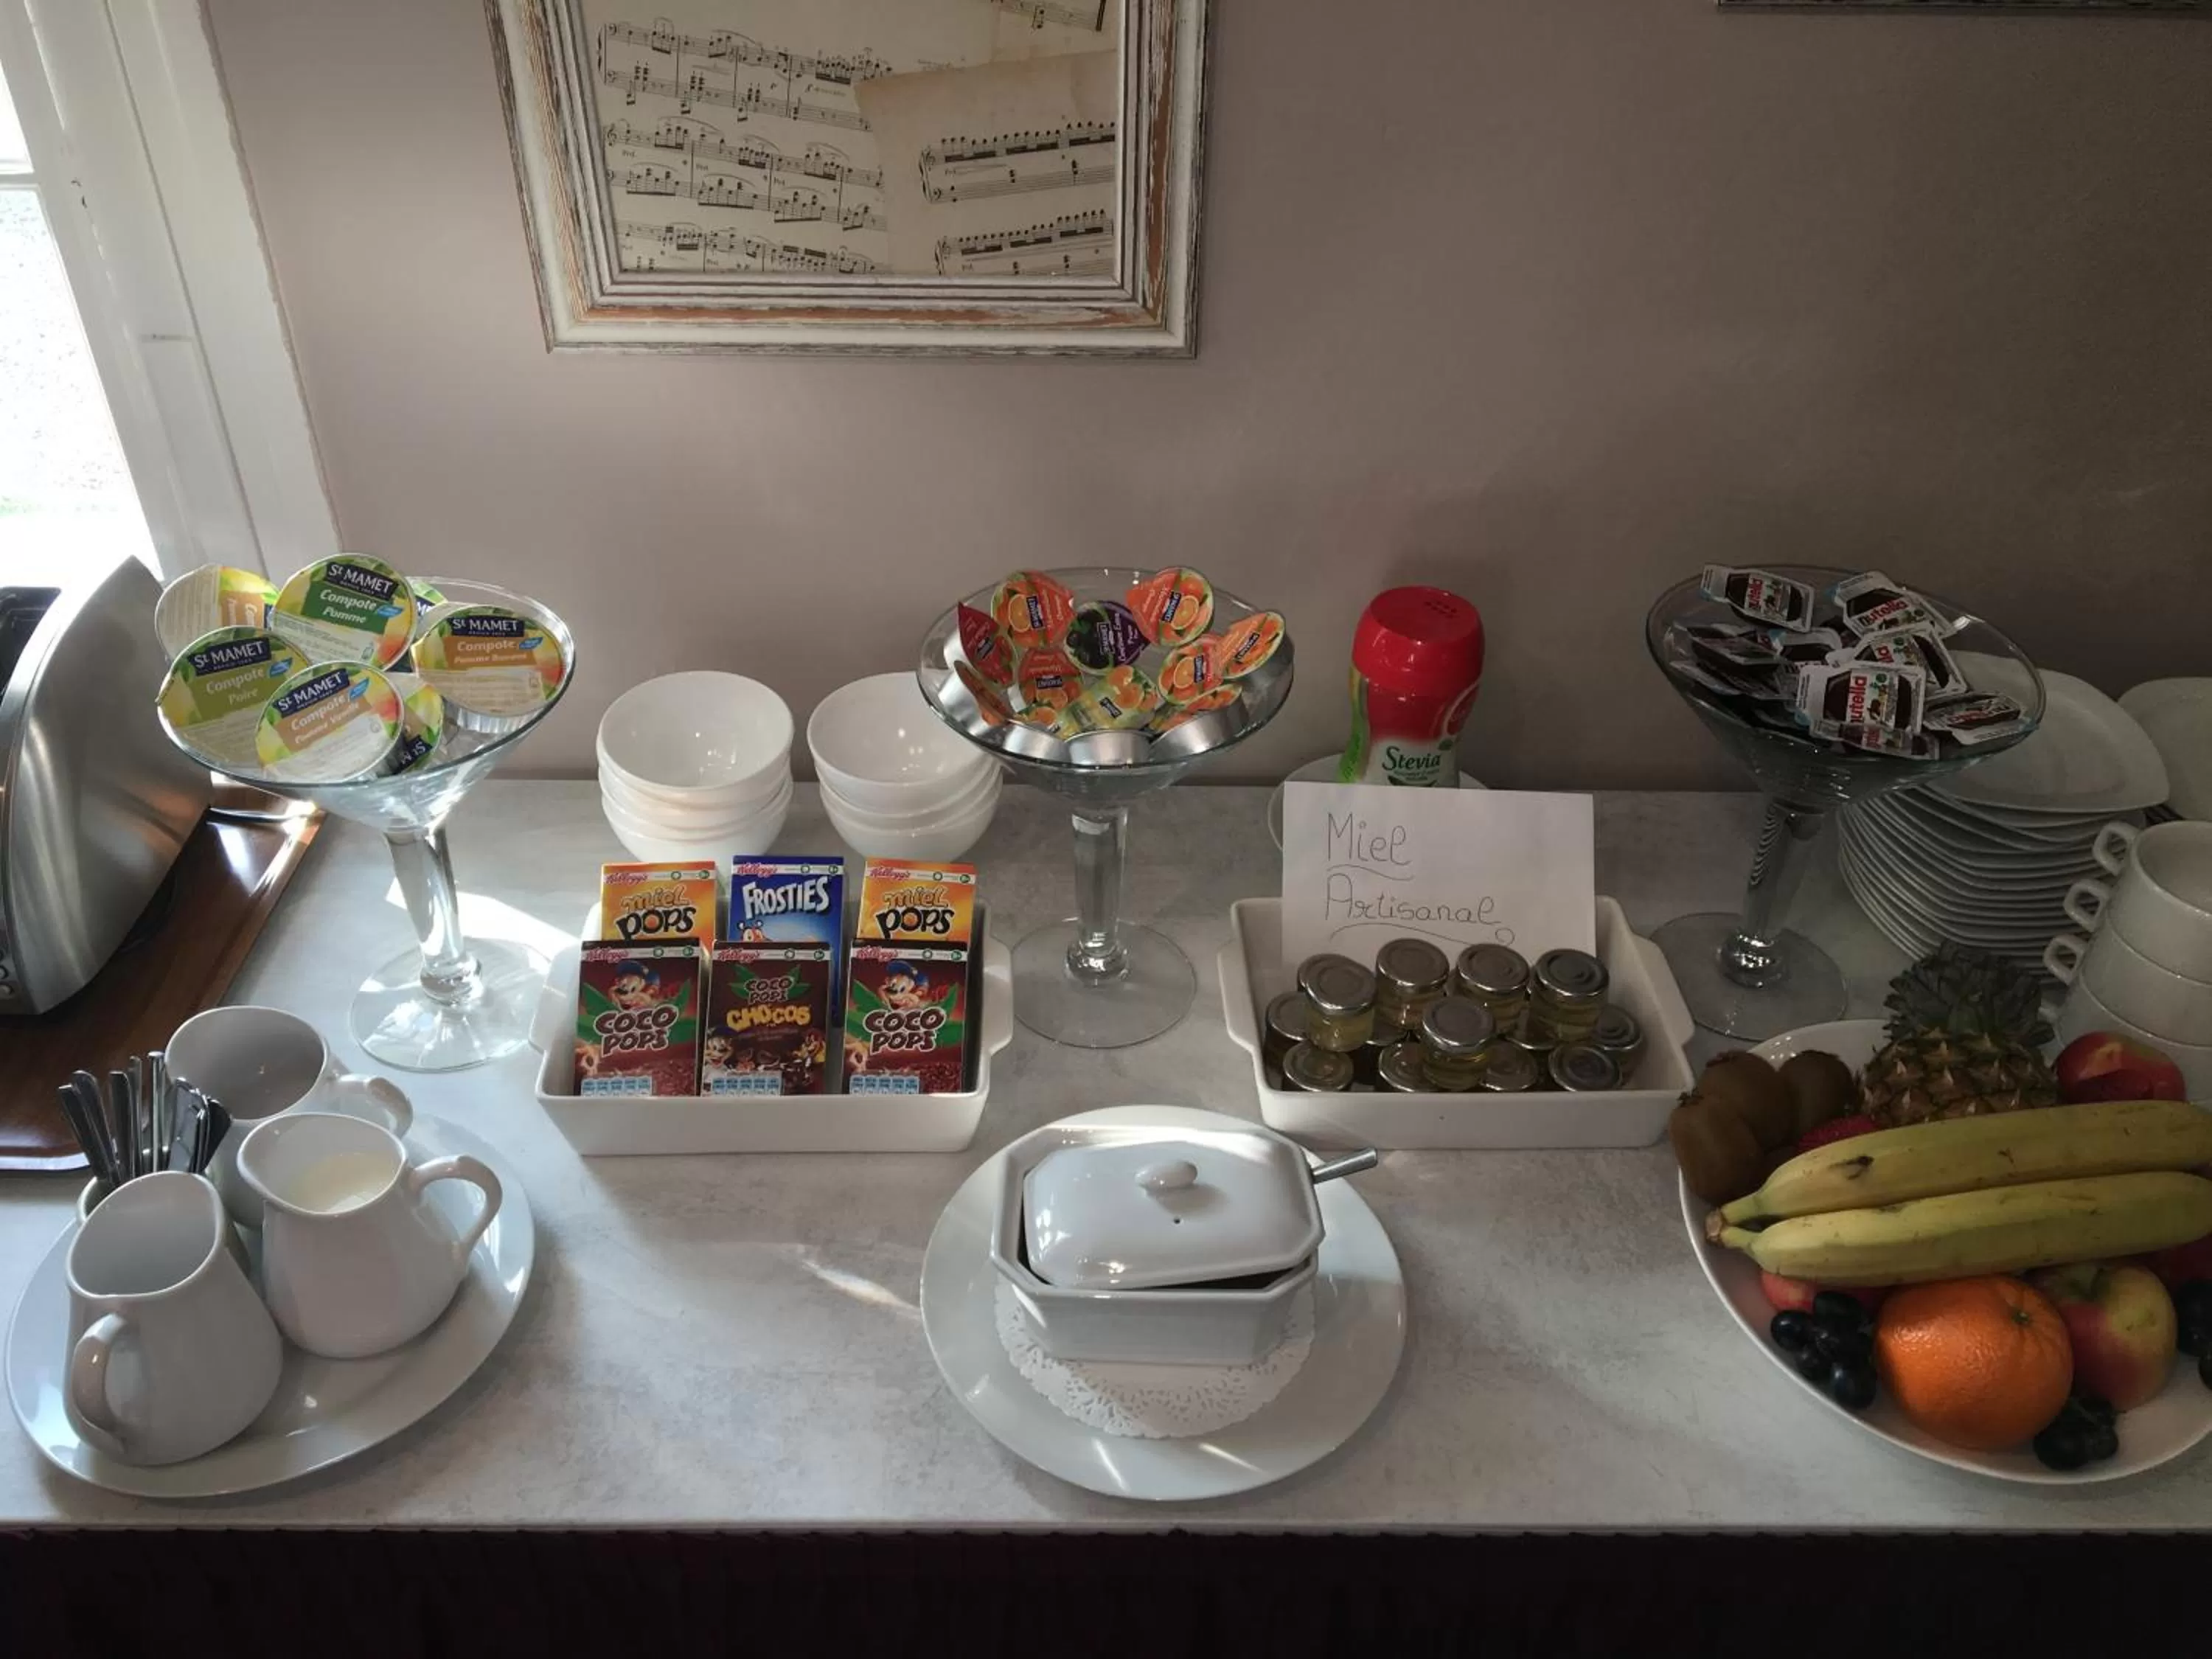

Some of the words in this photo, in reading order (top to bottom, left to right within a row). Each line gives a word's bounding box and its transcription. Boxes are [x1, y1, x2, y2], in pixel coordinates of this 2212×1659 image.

[344, 568, 393, 594] MAMET
[320, 590, 377, 611] Compote
[322, 606, 366, 624] Pomme
[469, 619, 518, 631] MAMET
[210, 641, 264, 664] MAMET
[457, 639, 516, 653] Compote
[206, 668, 264, 695] Compote
[293, 672, 344, 704] MAMET
[229, 689, 258, 706] Poire
[291, 694, 347, 731] Compote
[1382, 745, 1441, 771] Stevia
[1326, 813, 1412, 866] Miel
[742, 876, 830, 920] FROSTIES
[1325, 872, 1502, 925] Artisanal
[744, 976, 794, 992] COCO
[749, 991, 789, 1004] POPS
[594, 1004, 679, 1035] COCO
[726, 1005, 811, 1032] CHOCOS
[863, 1006, 947, 1033] COCO
[602, 1030, 670, 1058] POPS
[870, 1031, 937, 1056] POPS
